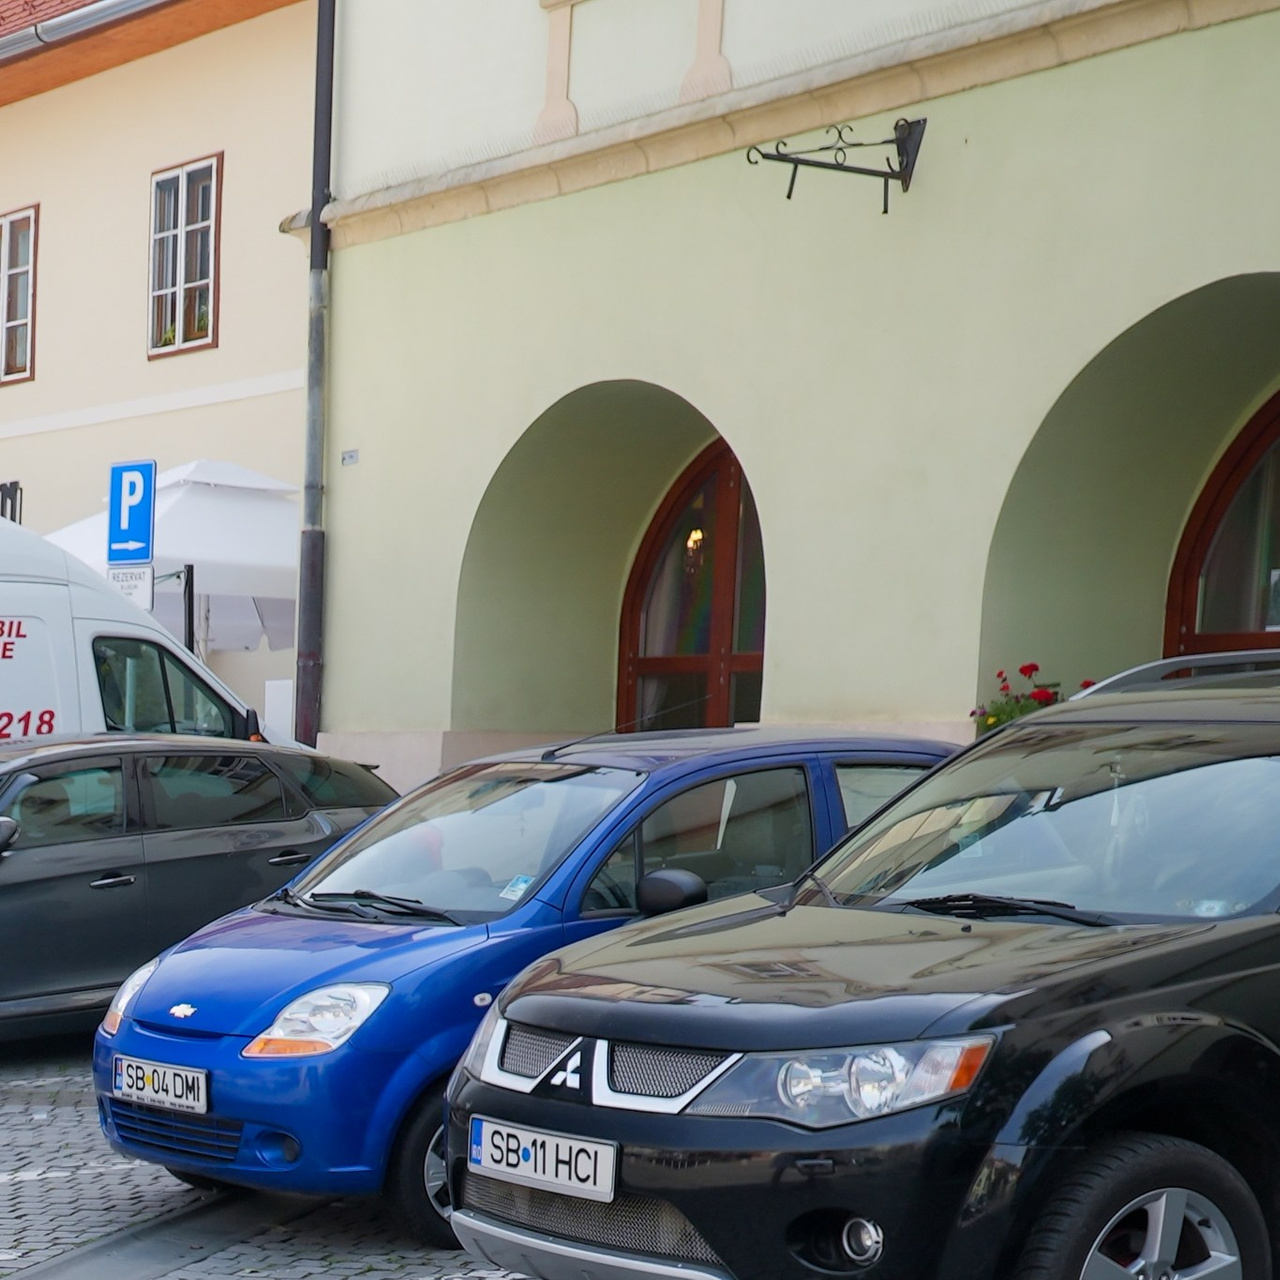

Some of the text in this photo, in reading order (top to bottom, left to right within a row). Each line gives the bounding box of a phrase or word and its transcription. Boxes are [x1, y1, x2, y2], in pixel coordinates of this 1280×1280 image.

[120, 470, 145, 531] P
[126, 1063, 146, 1091] SB
[152, 1069, 169, 1097] 04
[173, 1072, 200, 1103] DMI
[490, 1130, 521, 1168] SB
[531, 1138, 546, 1175] 11
[555, 1143, 598, 1186] HCI
